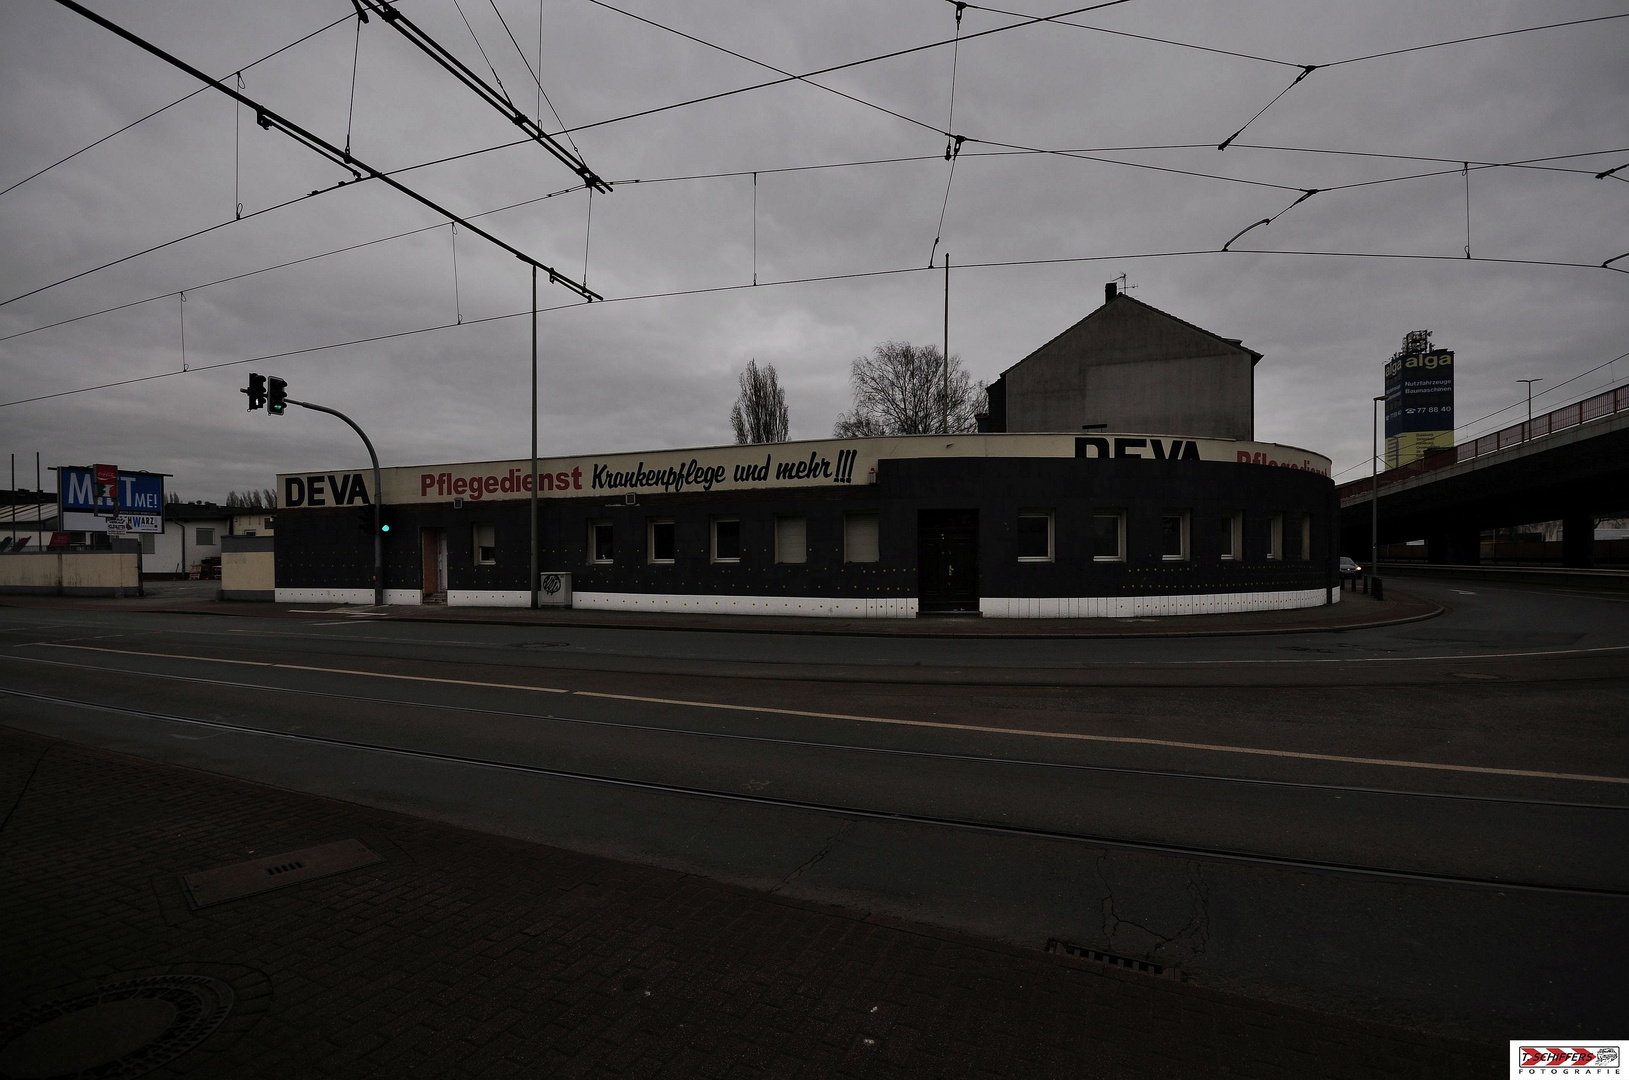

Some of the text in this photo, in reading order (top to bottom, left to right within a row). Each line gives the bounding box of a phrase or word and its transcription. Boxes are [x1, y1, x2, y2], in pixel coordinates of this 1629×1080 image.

[1405, 353, 1452, 369] alga
[285, 473, 370, 507] DEVA
[421, 465, 583, 500] Pflegedienst
[592, 459, 726, 492] Krankenpflege
[733, 454, 771, 482] und
[135, 493, 157, 509] ME!
